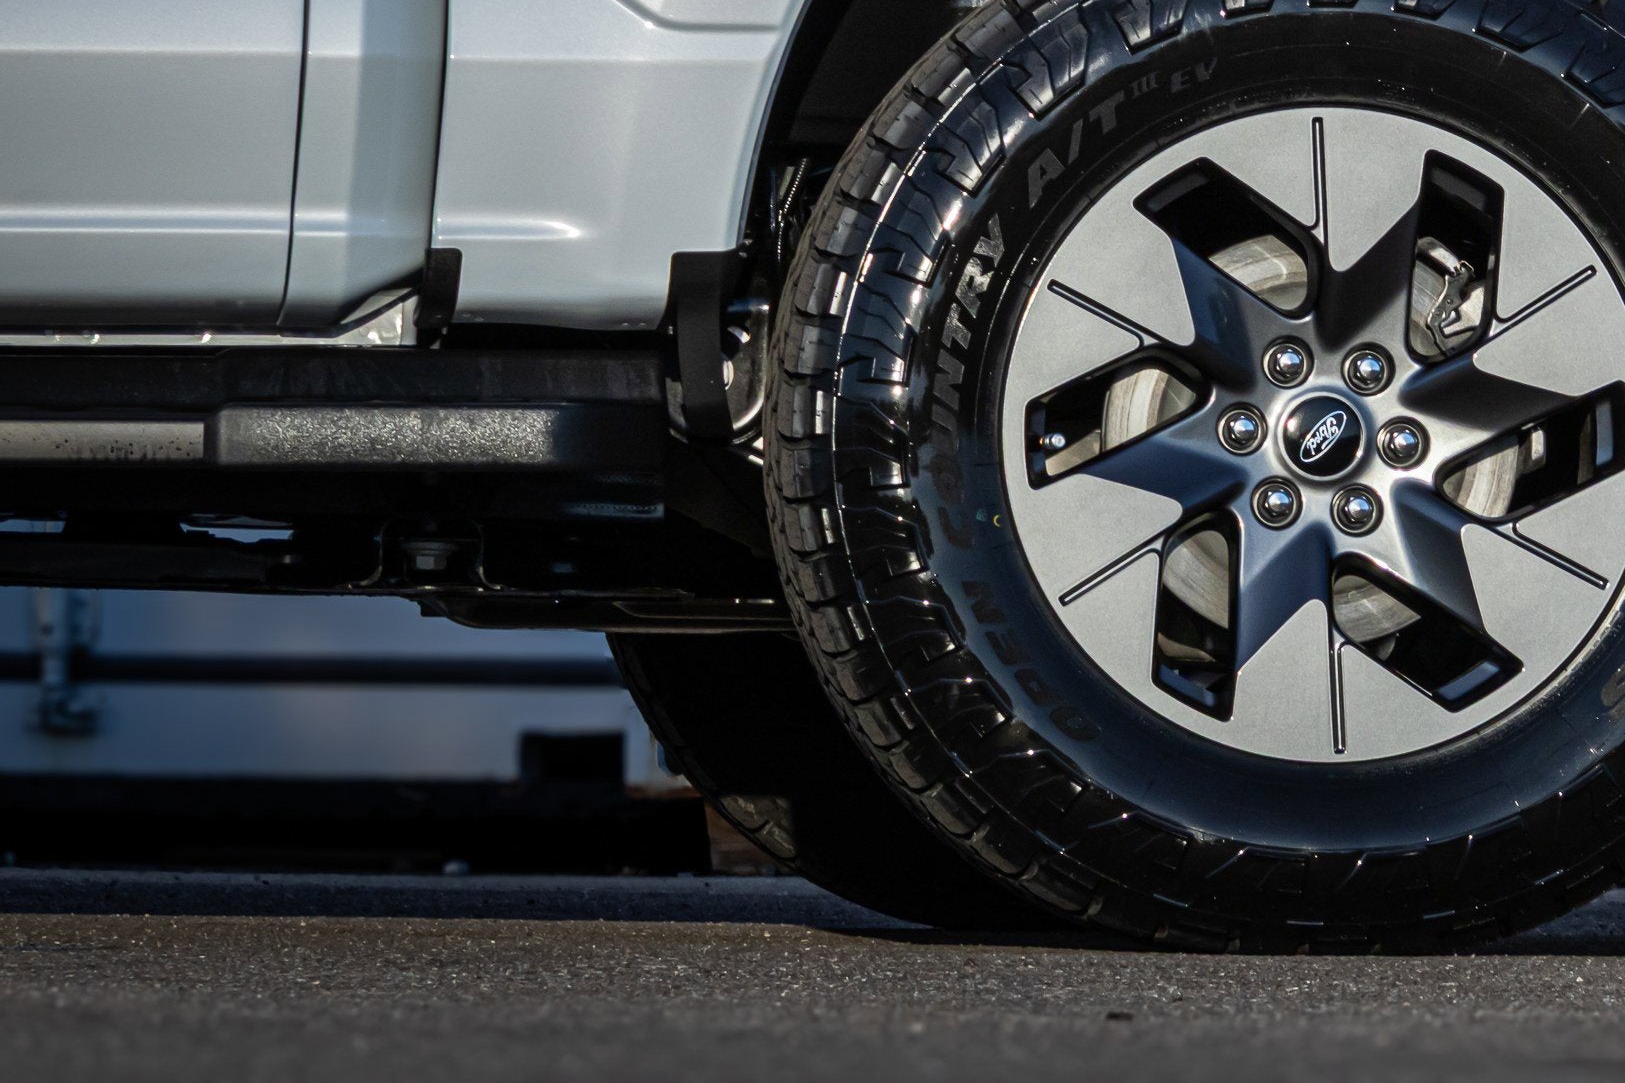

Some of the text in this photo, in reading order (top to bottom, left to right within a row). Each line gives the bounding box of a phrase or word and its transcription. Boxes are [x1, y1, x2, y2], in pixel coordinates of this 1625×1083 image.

[1170, 56, 1218, 93] EV
[1027, 89, 1125, 211] A/T
[930, 212, 1006, 550] COUNTRY
[961, 580, 1101, 743] OPEN
